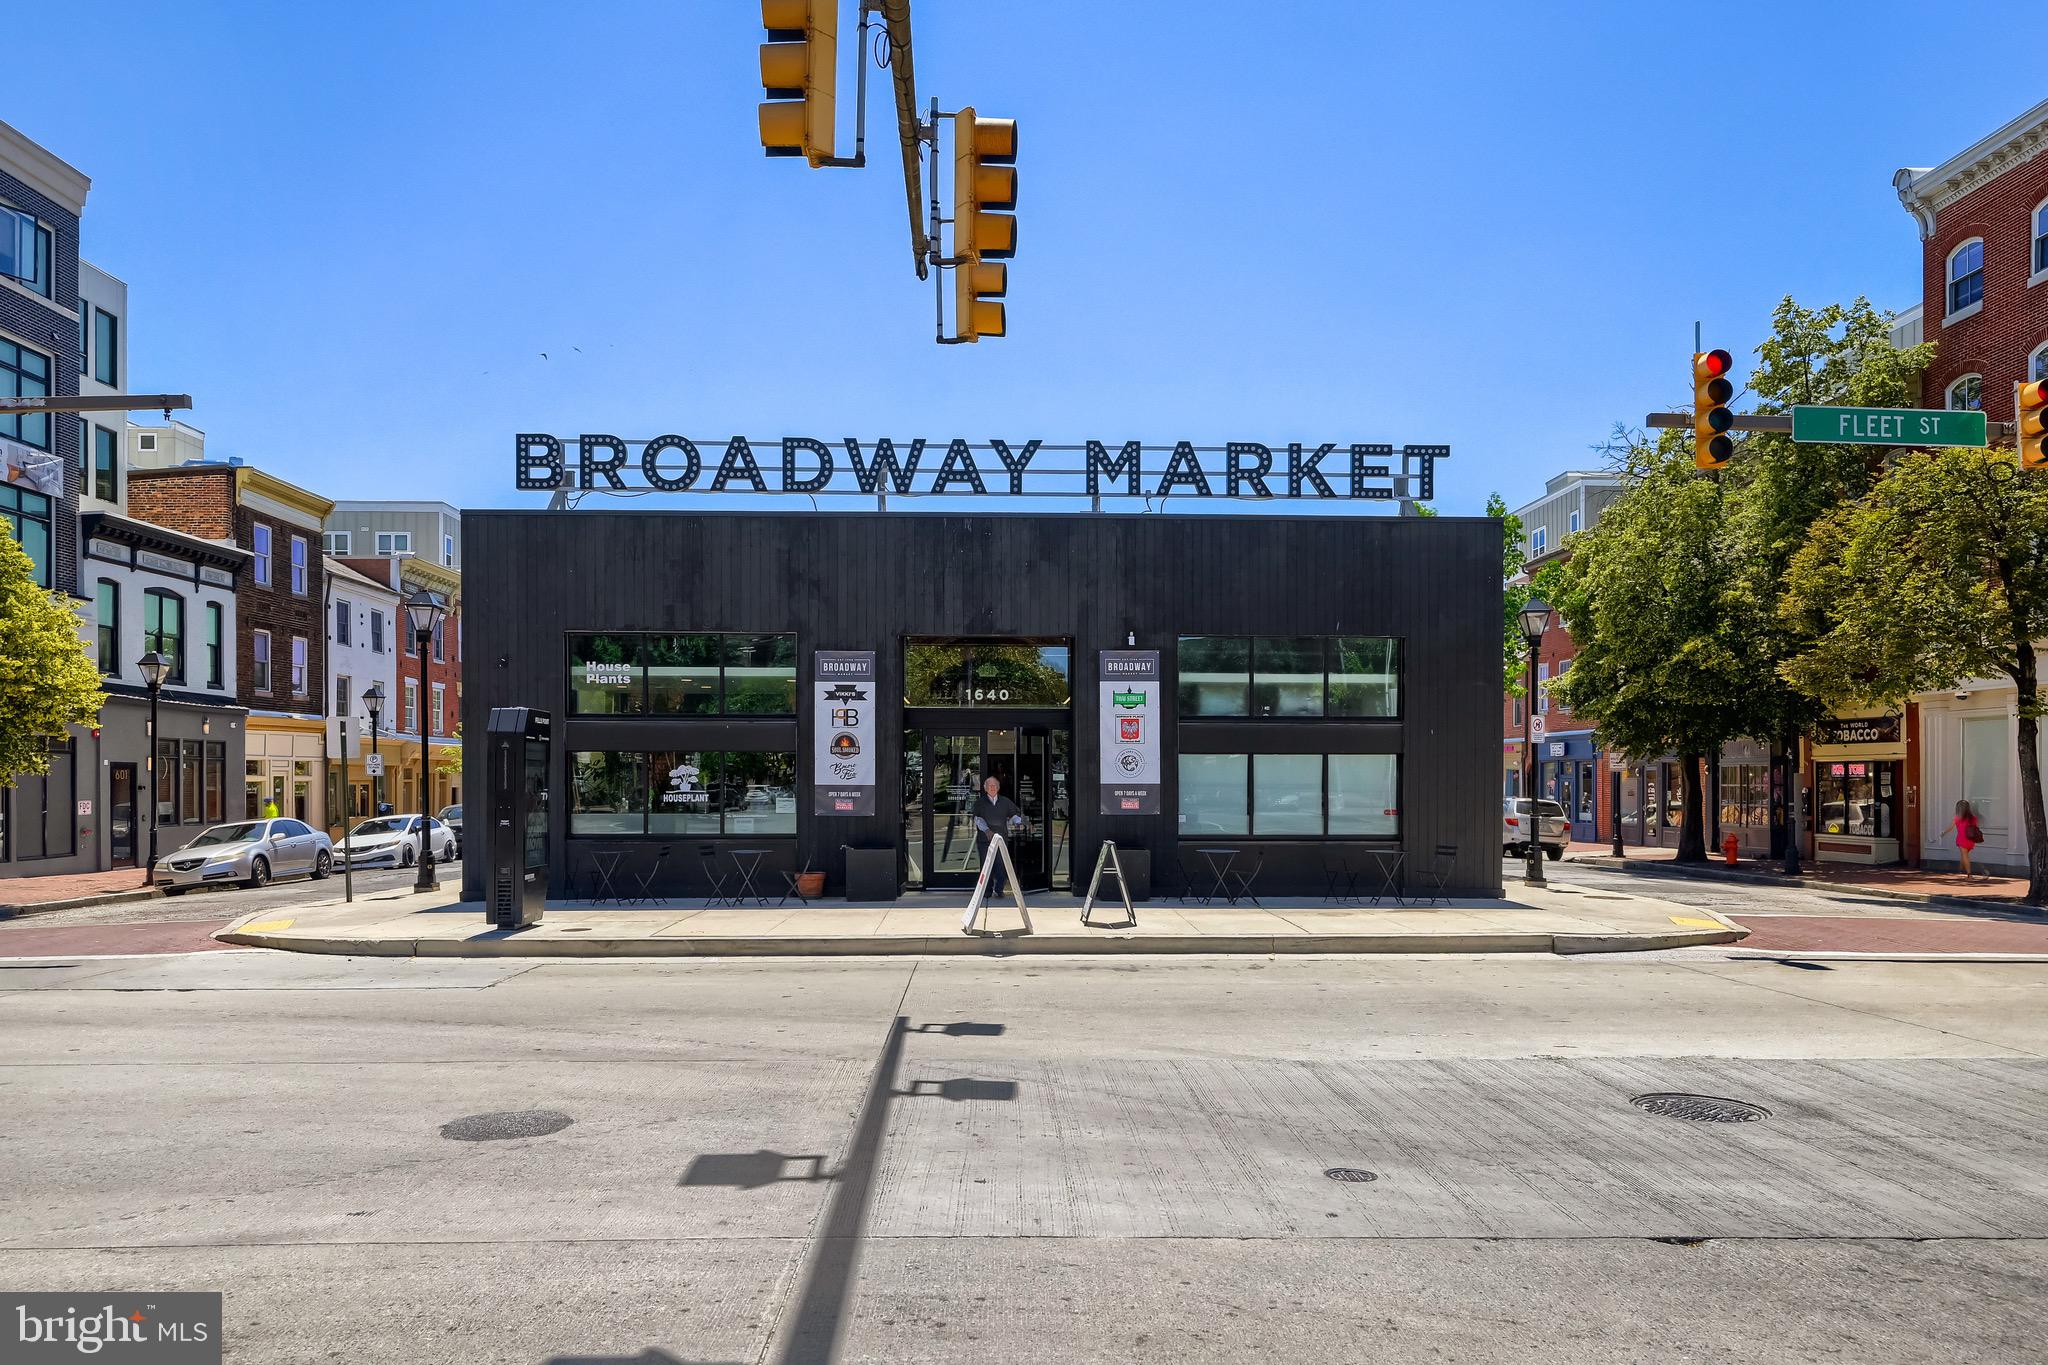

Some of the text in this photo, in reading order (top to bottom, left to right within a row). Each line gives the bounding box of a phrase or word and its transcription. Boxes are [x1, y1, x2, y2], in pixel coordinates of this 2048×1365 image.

[1839, 414, 1941, 438] FLEET ST
[515, 433, 1451, 500] BROADWAY MARKET
[586, 660, 631, 672] House
[823, 662, 868, 672] BROADWAY
[1107, 662, 1152, 671] BROADWAY
[586, 673, 631, 684] Plants
[965, 688, 1010, 701] 1640
[1849, 721, 1869, 729] WORLD
[1834, 728, 1879, 742] OBACCO
[115, 769, 128, 780] 601
[663, 793, 709, 803] HOUSEPLANT
[80, 802, 90, 810] FDC
